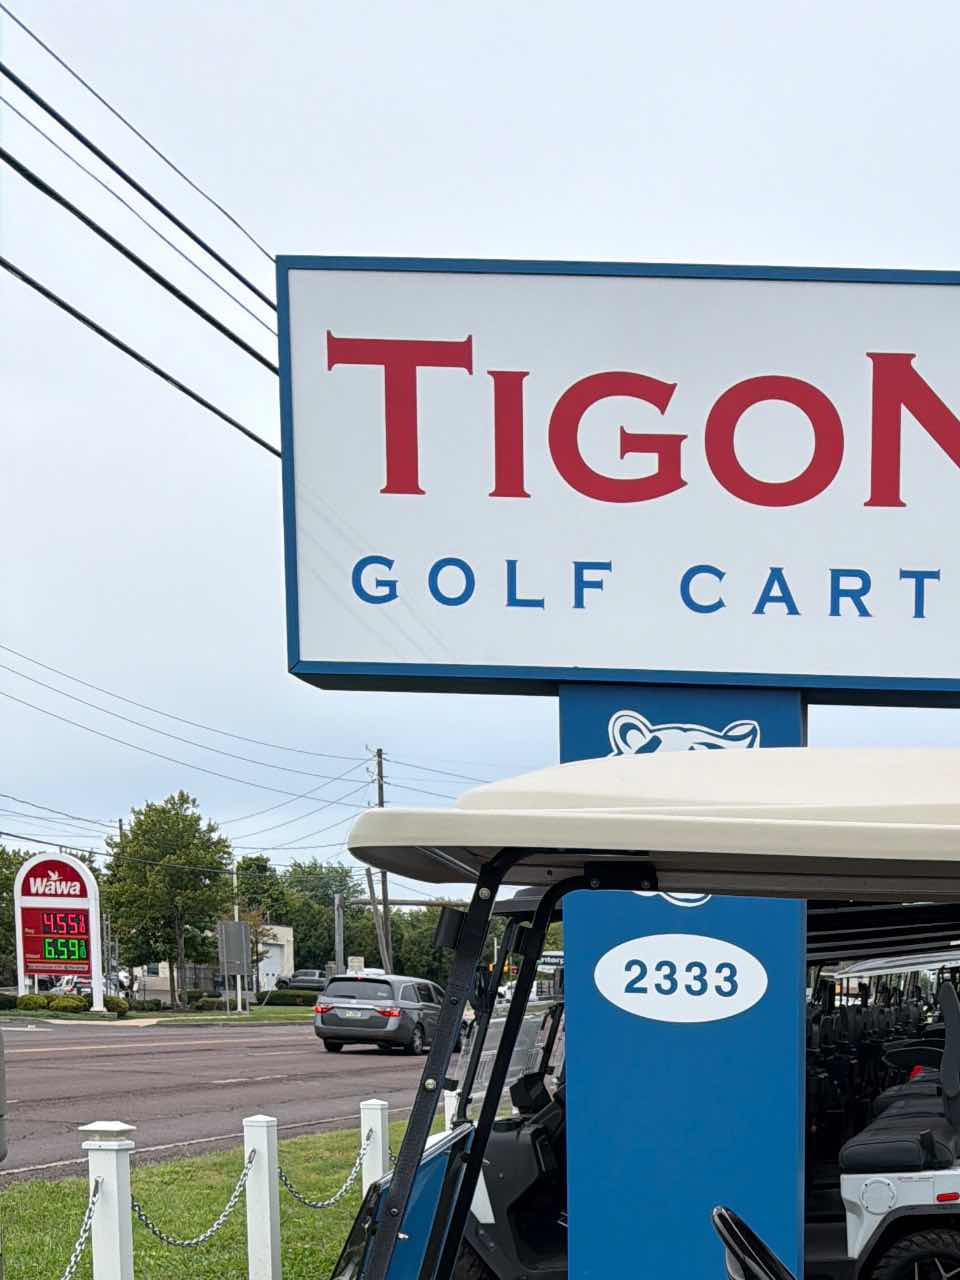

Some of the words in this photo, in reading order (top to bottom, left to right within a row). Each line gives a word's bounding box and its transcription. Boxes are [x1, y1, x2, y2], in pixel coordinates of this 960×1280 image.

[352, 555, 613, 610] GOLF
[28, 877, 81, 895] Wawa
[624, 959, 739, 998] 2333
